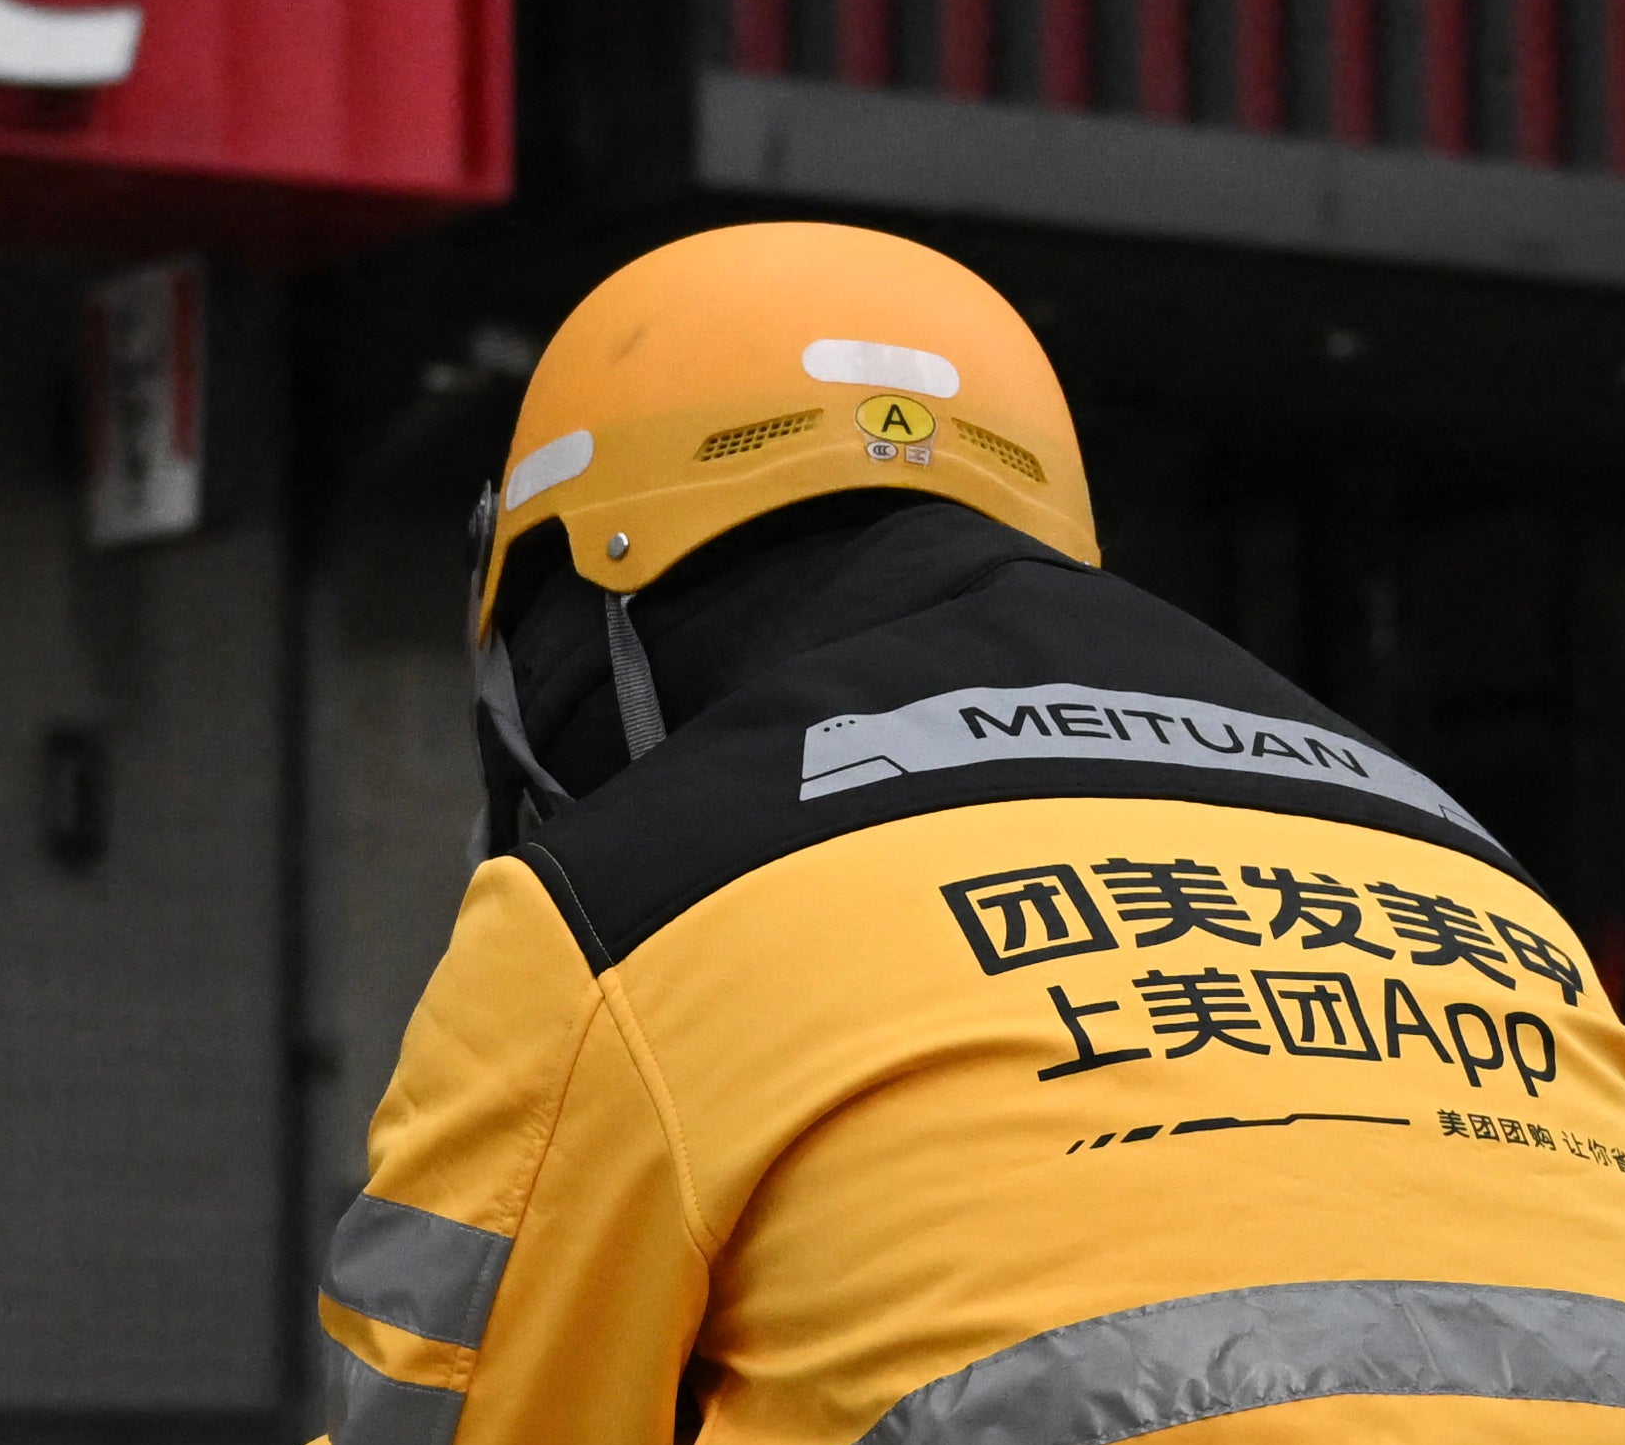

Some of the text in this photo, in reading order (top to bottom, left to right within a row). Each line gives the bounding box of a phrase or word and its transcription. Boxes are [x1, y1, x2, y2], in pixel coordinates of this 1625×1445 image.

[881, 404, 912, 435] A
[959, 702, 1370, 778] MEITUAN
[940, 857, 1587, 1008] 团美发美甲
[1036, 968, 1557, 1097] 上美团App
[1436, 1108, 1557, 1151] 美团团购
